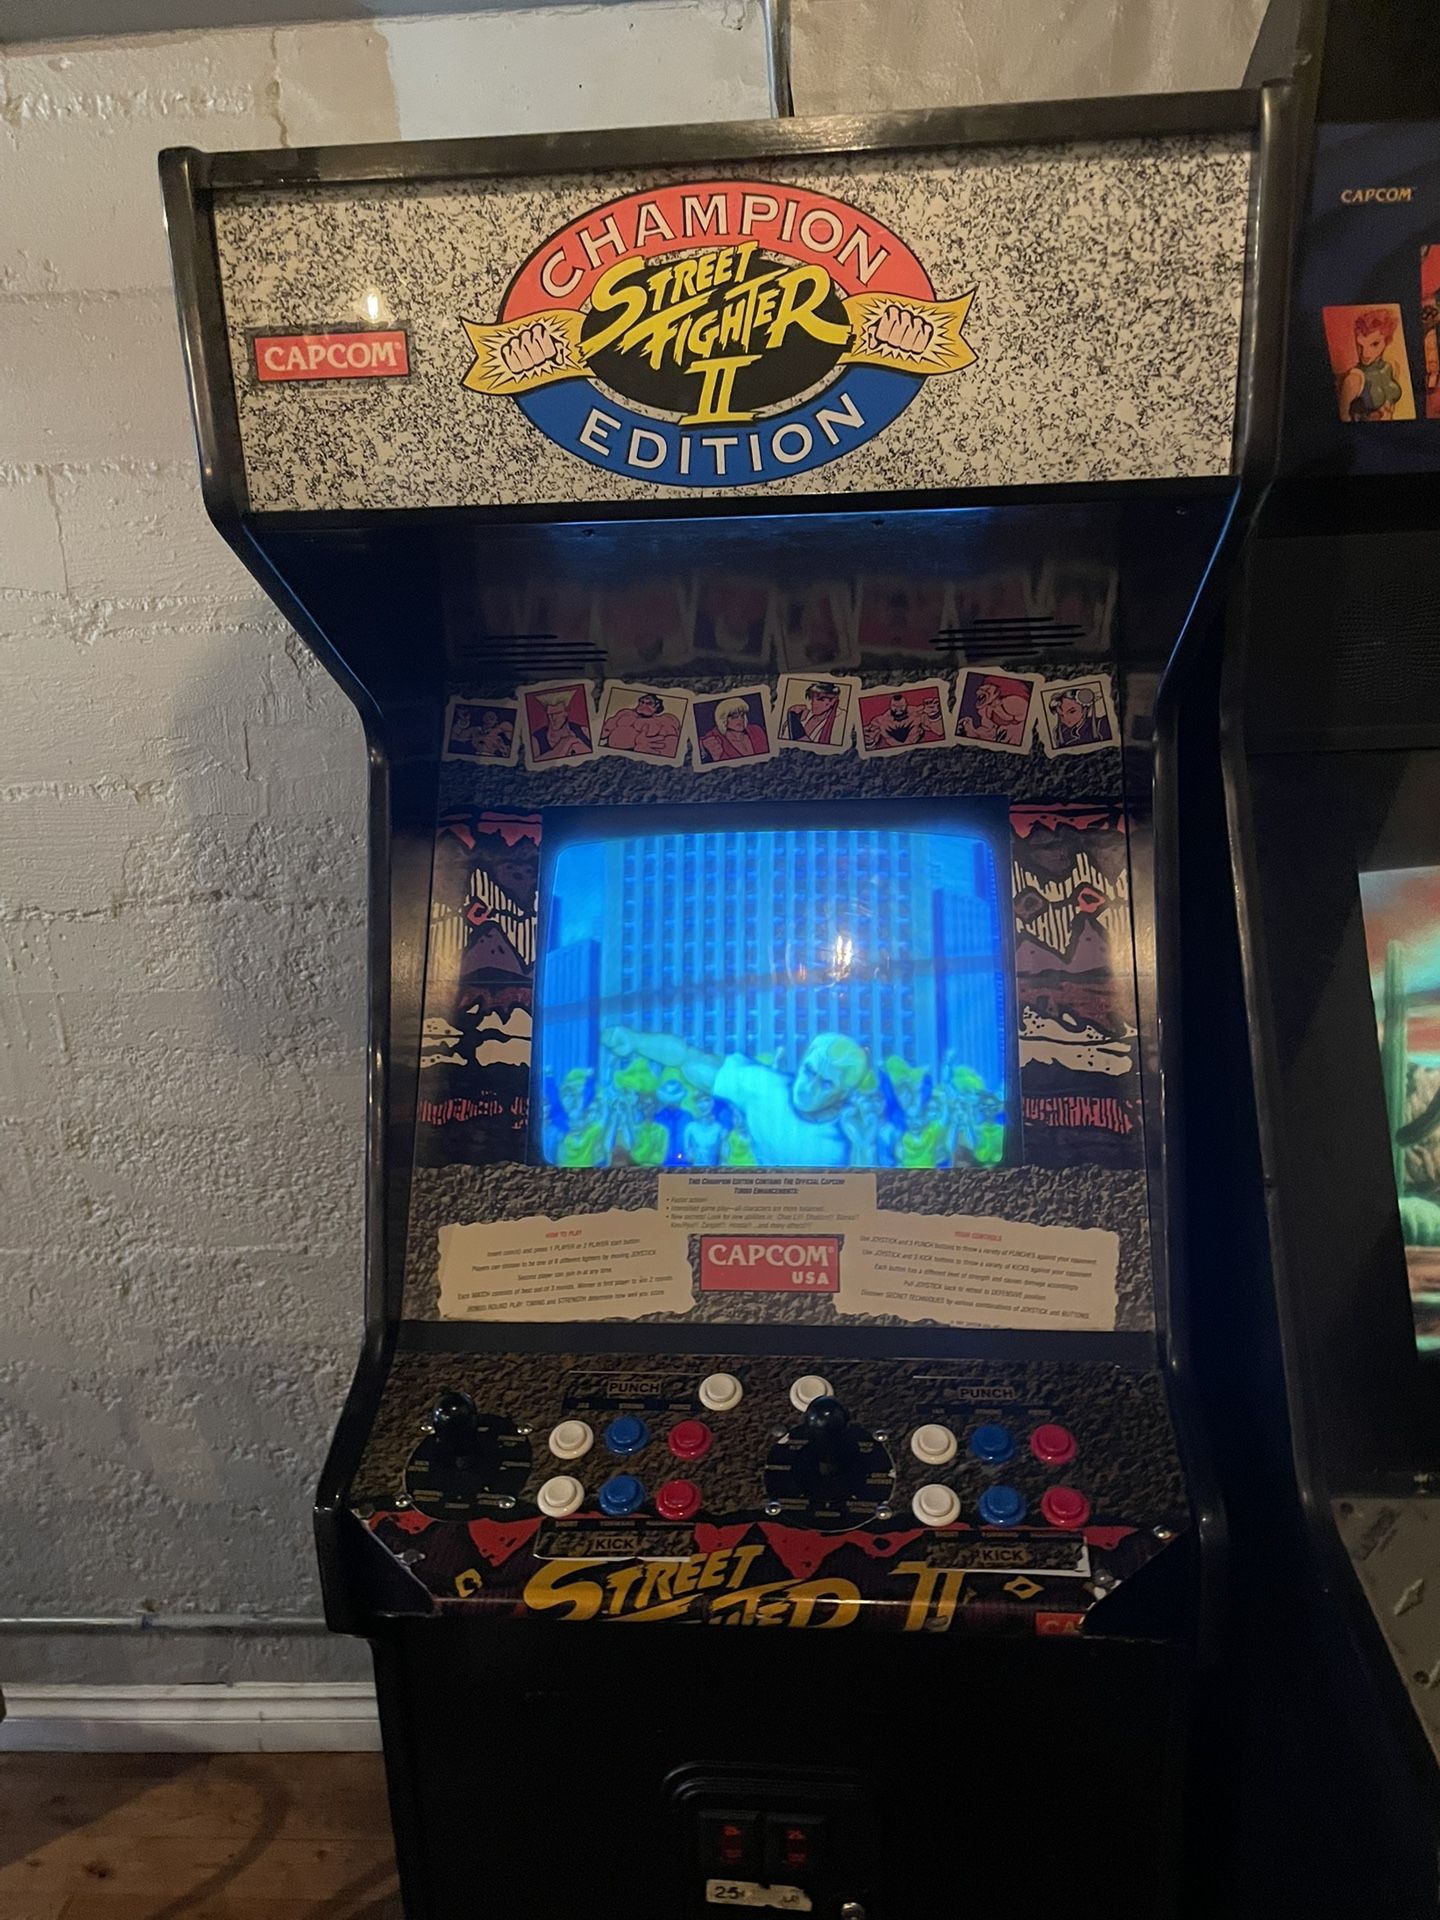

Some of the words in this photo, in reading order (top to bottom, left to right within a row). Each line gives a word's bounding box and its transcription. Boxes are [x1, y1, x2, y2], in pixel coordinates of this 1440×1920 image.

[1341, 187, 1412, 203] CAPCOM
[541, 192, 888, 299] CHAMPION
[577, 241, 760, 362] STREET
[613, 265, 854, 371] FIGHTER
[264, 341, 398, 372] CAPCOM
[677, 354, 763, 426] II
[579, 393, 866, 475] EDITION
[708, 1244, 830, 1267] CAPCOM
[791, 1271, 830, 1285] USA
[609, 1383, 660, 1393] PUNCH
[960, 1388, 1014, 1398] PUNCH
[595, 1538, 635, 1550] KICK
[983, 1549, 1025, 1561] KICK
[523, 1544, 766, 1621] STREET
